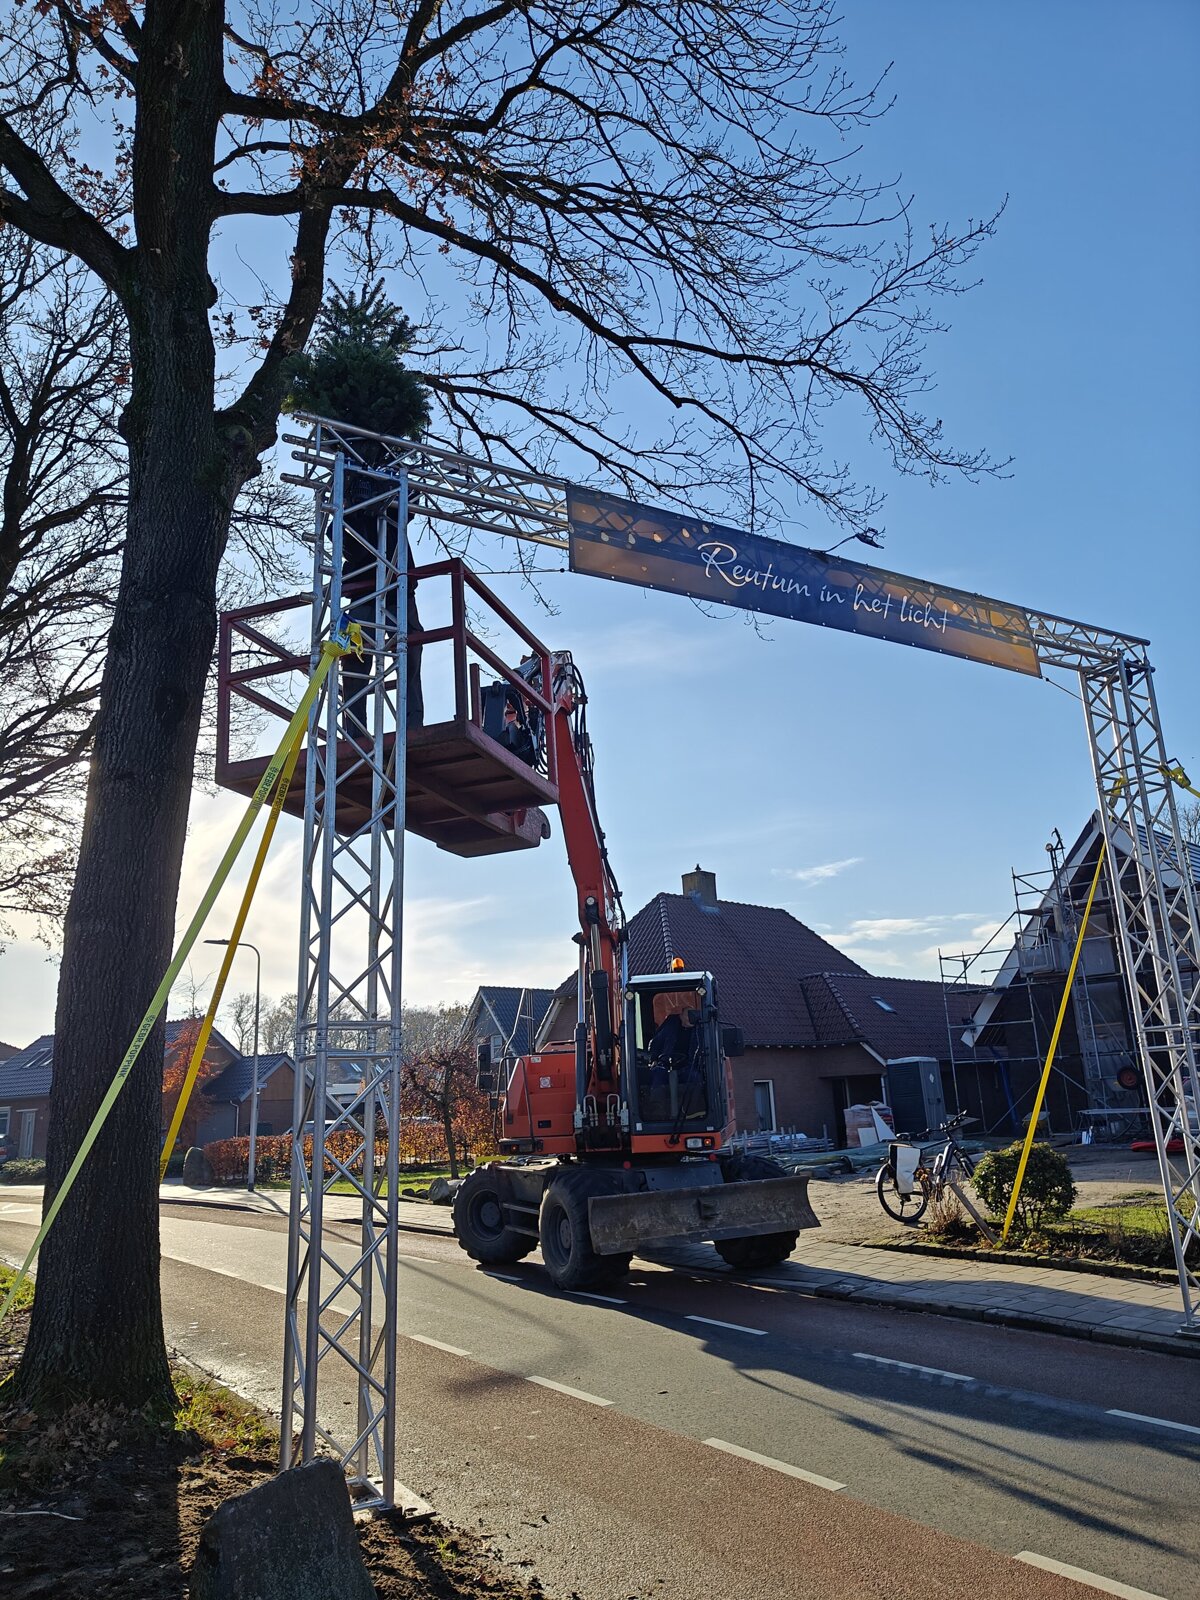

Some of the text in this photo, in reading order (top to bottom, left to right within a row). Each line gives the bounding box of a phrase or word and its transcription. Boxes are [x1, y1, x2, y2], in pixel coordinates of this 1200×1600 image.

[697, 542, 953, 634] Reutum in het licht
